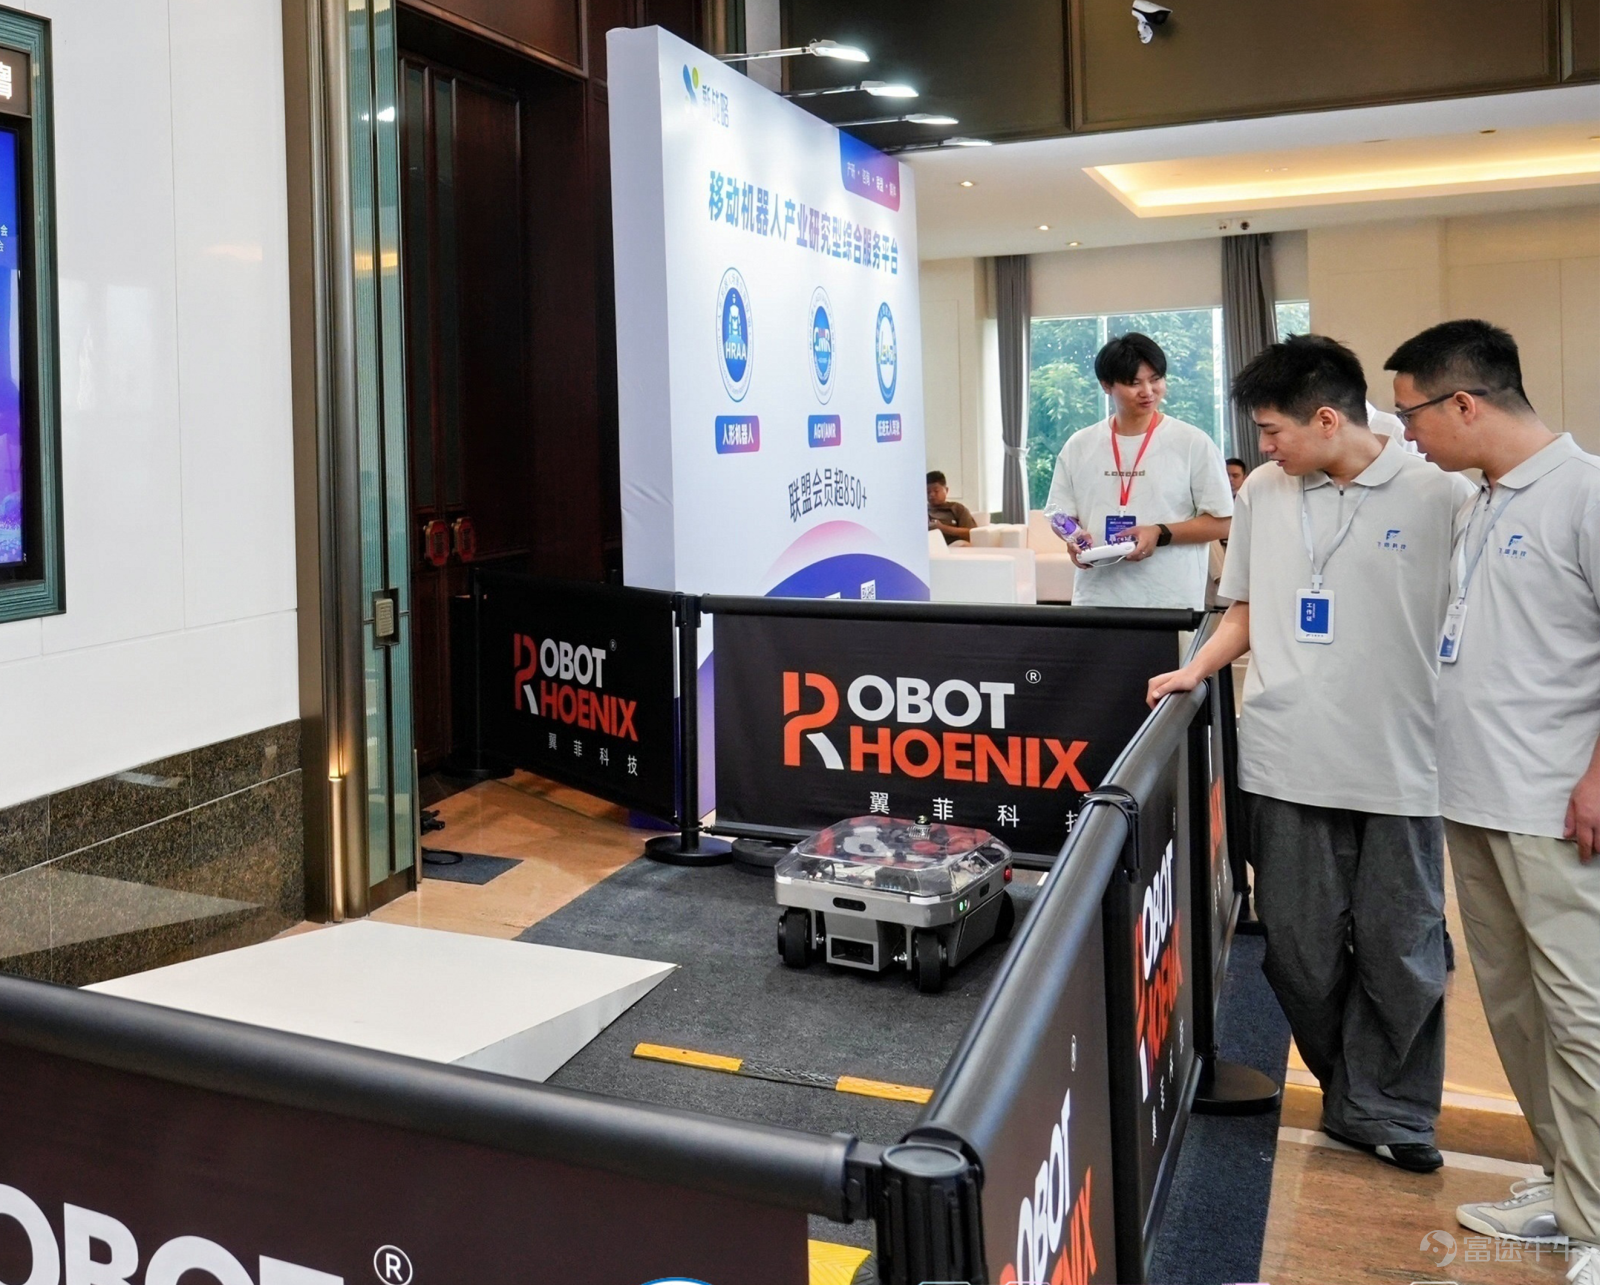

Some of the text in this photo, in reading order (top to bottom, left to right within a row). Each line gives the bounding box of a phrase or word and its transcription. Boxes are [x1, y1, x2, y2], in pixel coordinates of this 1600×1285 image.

[708, 170, 899, 275] 移动机器人产业研究型综合服务平台
[722, 422, 755, 445] 人形机器人
[788, 467, 867, 523] 联盟会员超850+
[548, 732, 638, 776] 翼菲科技
